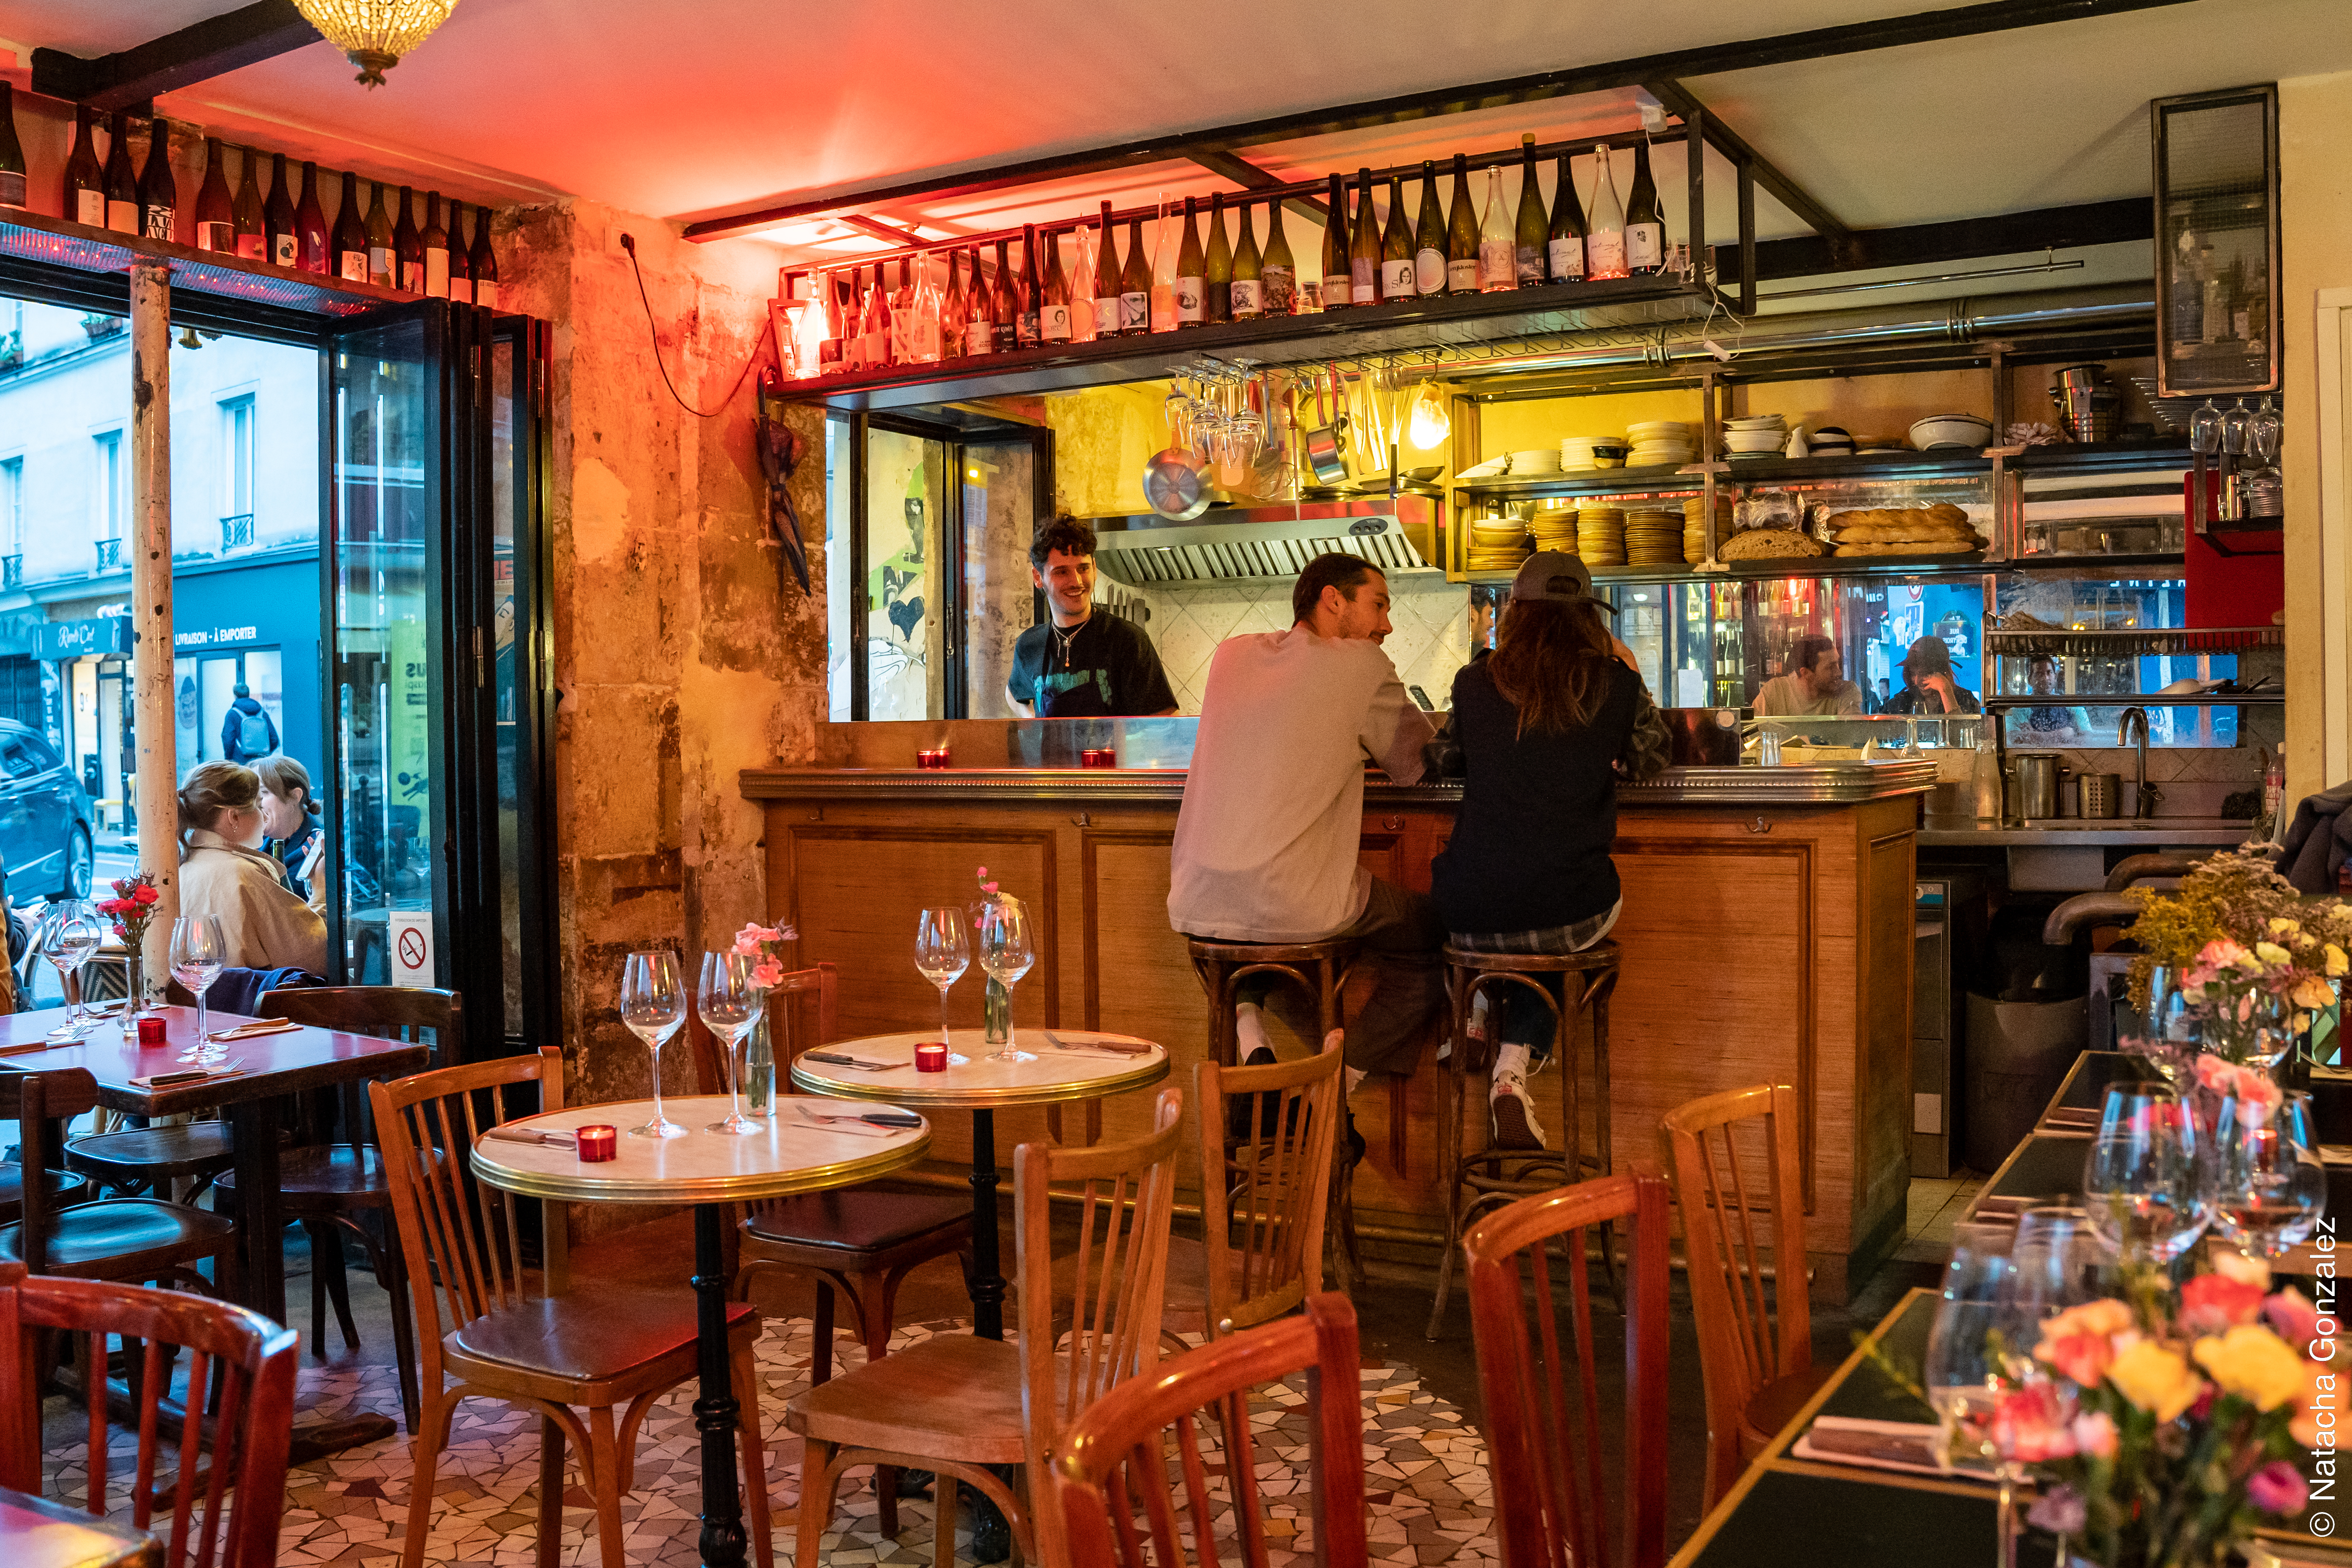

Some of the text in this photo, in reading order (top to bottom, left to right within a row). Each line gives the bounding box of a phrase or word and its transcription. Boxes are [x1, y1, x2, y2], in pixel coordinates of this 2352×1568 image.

[175, 631, 208, 646] LIVRAISON
[214, 627, 219, 643] À
[220, 626, 257, 642] EMPORTER
